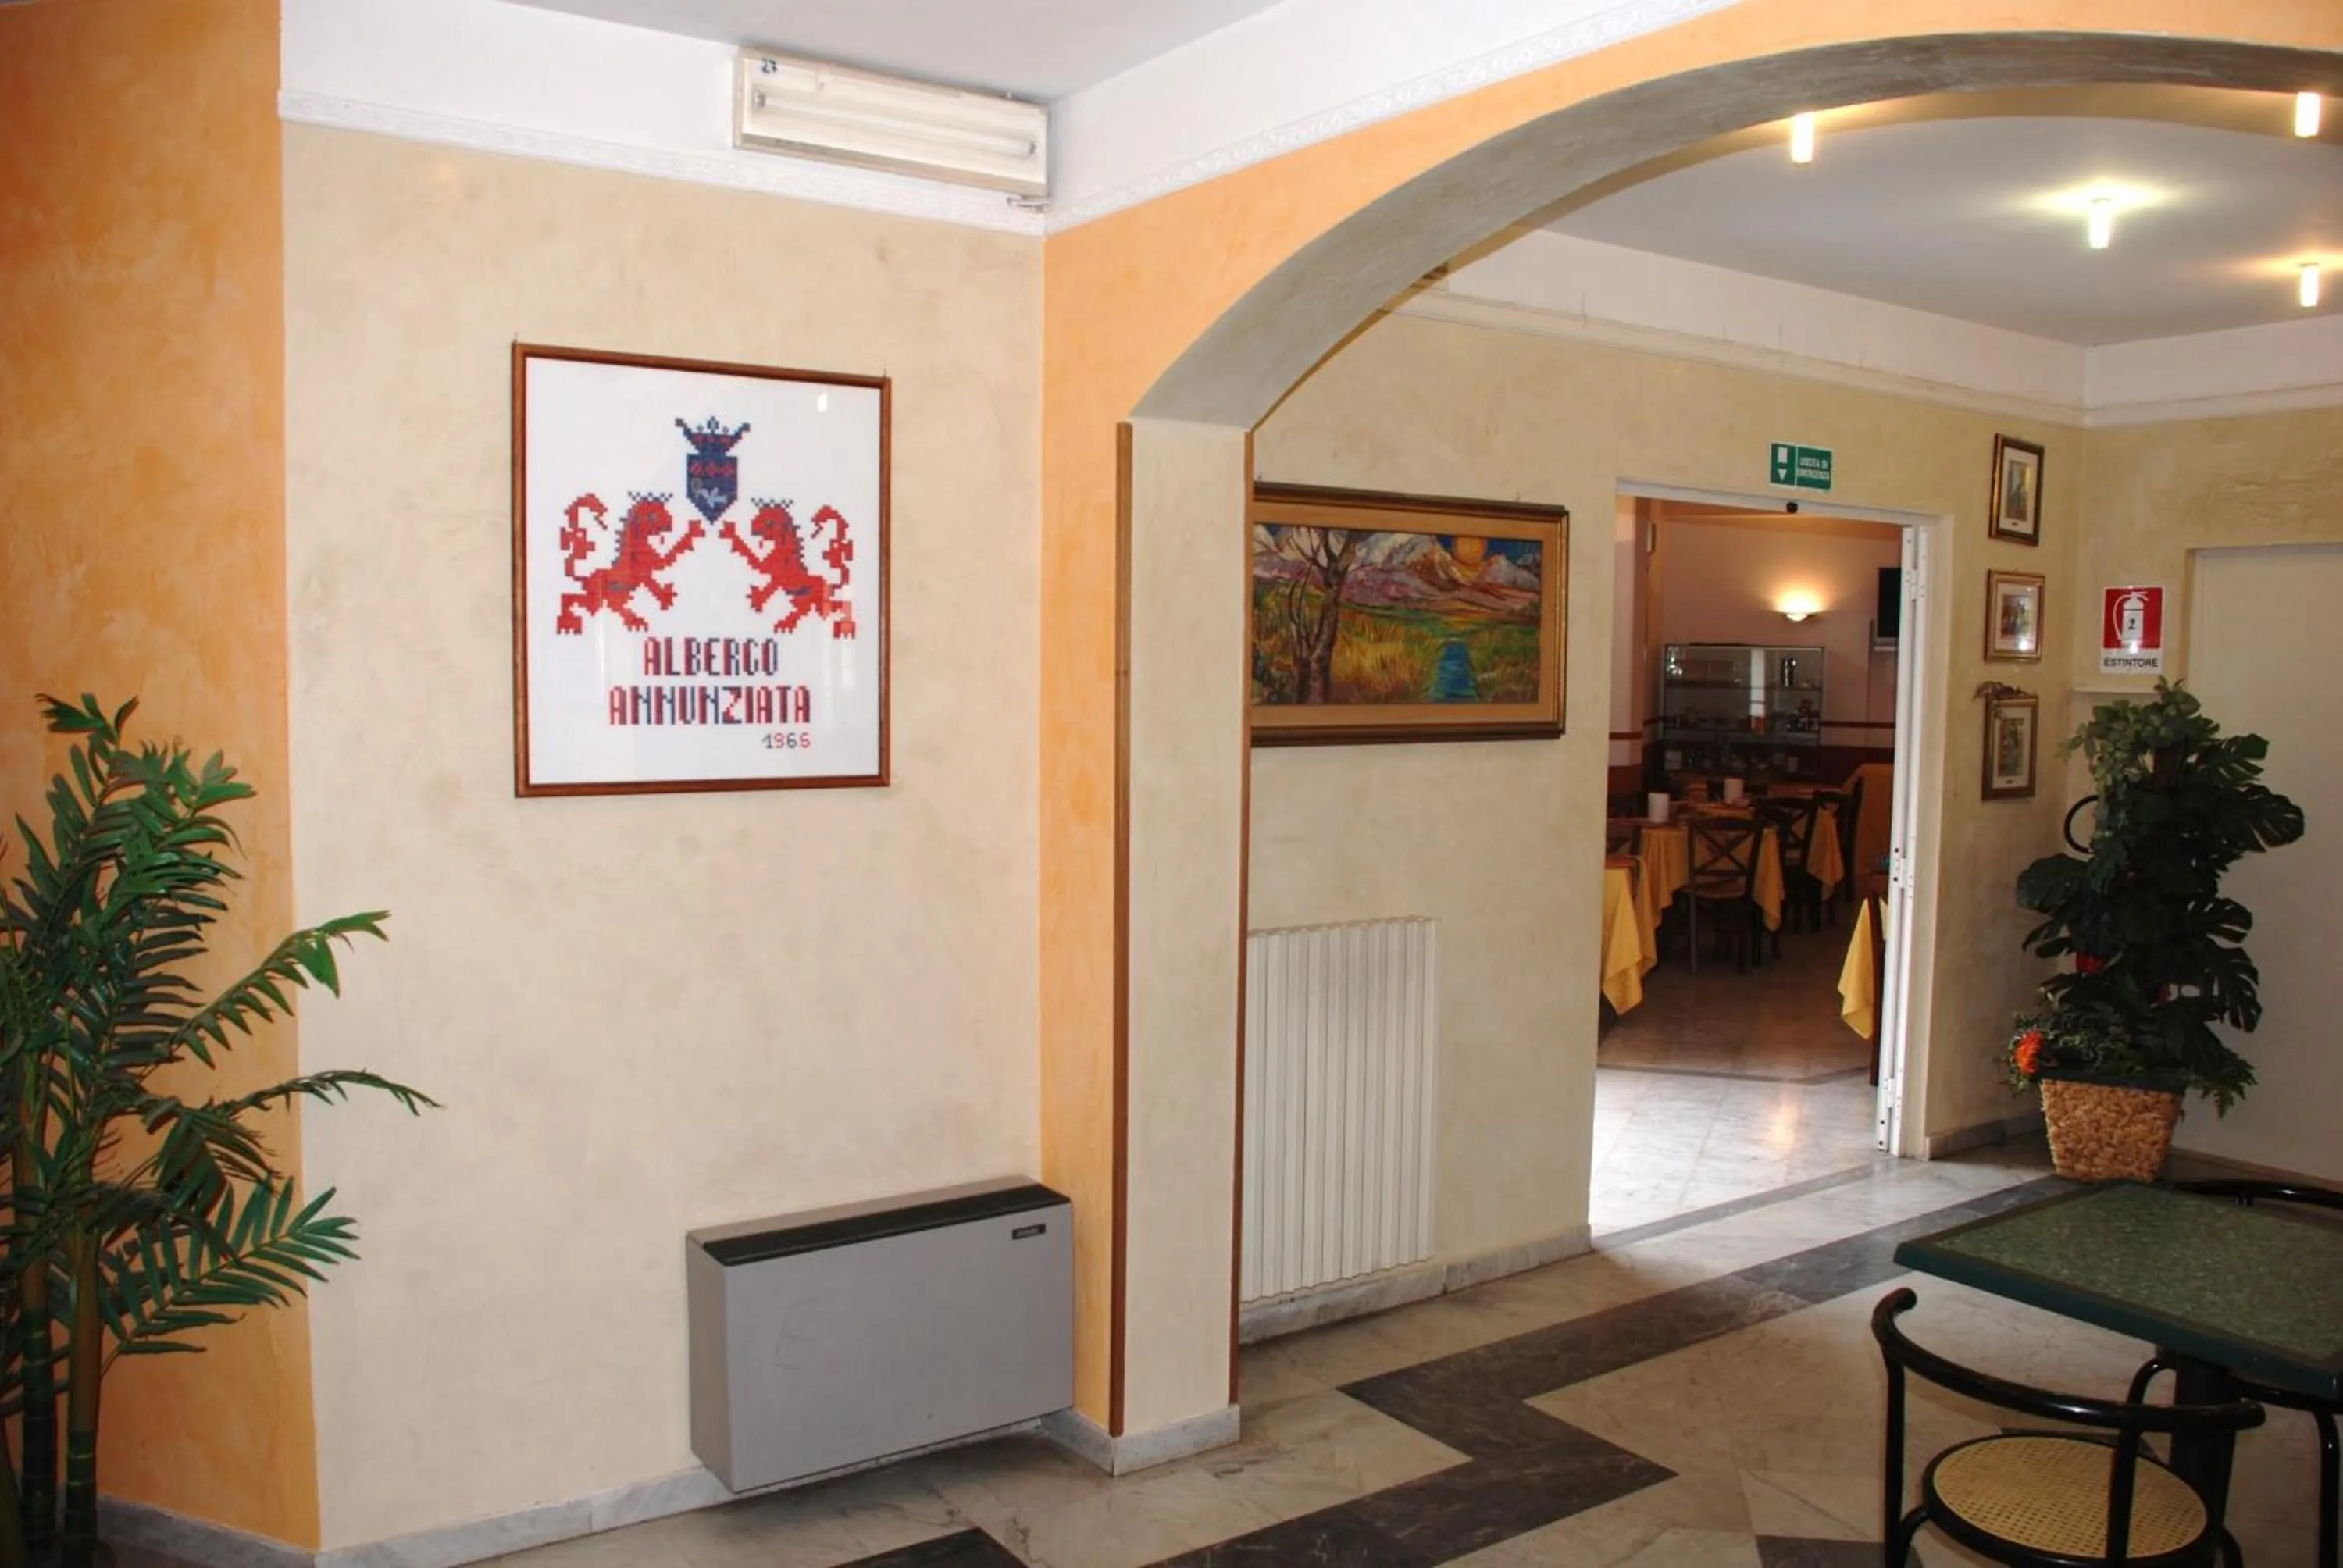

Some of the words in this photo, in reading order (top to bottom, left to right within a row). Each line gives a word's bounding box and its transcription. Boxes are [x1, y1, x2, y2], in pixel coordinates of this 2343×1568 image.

[644, 637, 778, 676] ALBERGO
[2103, 657, 2159, 668] ESTINTORE
[609, 686, 811, 725] ANNUNZIATA
[762, 732, 811, 749] 1966
